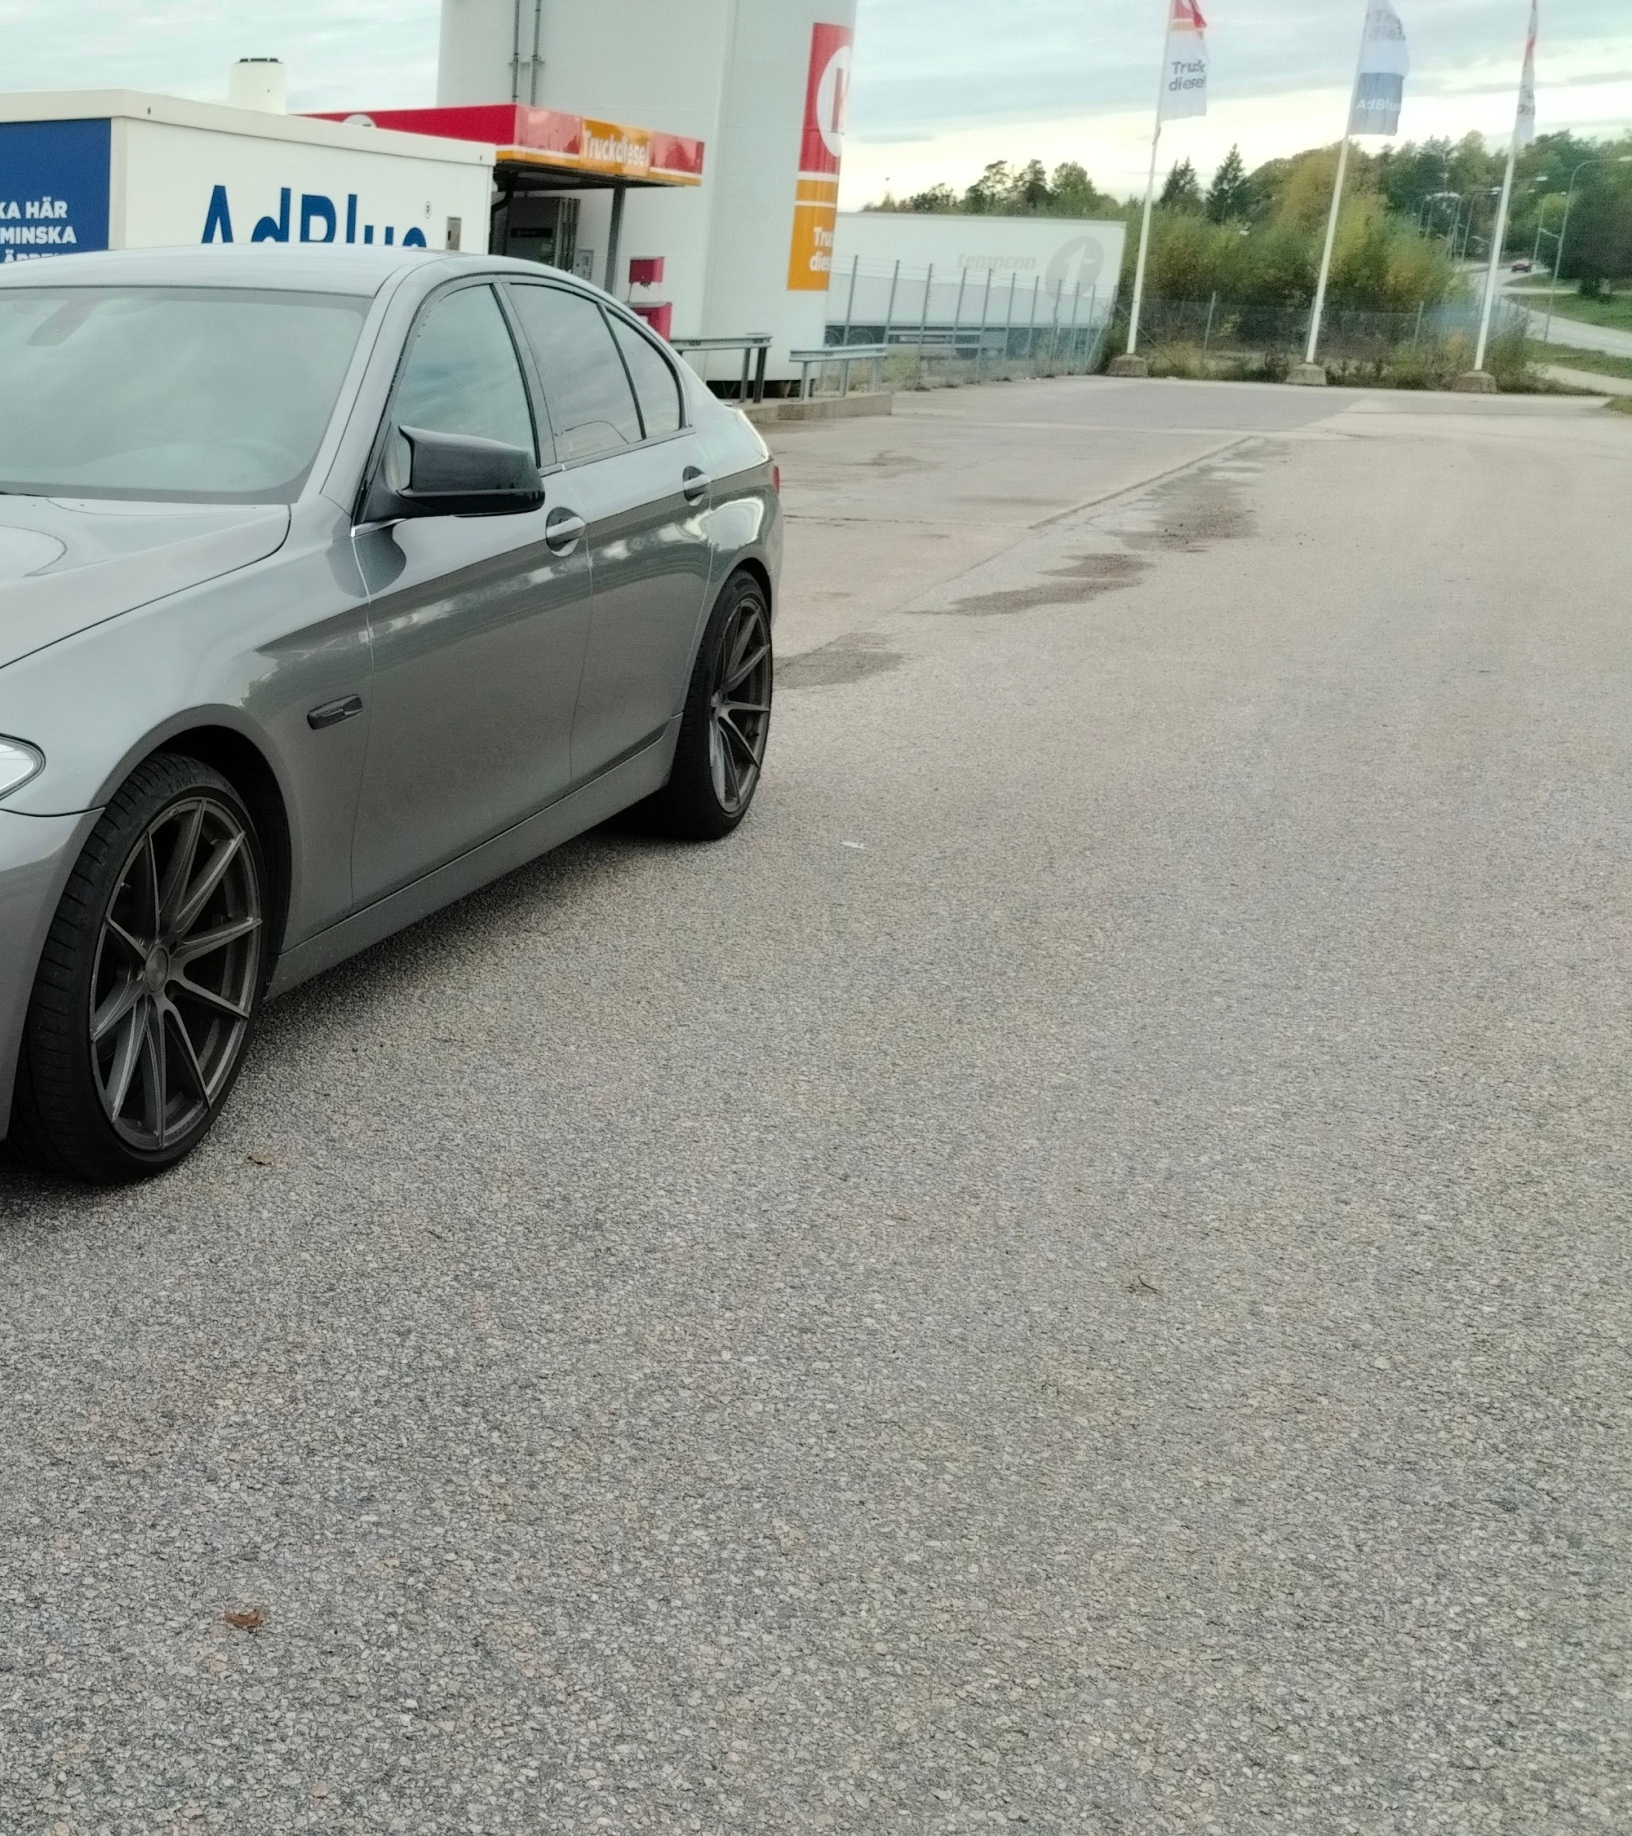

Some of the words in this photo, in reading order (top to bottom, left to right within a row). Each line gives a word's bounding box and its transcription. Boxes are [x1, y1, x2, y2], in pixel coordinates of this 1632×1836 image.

[25, 196, 68, 219] HÄR
[0, 226, 77, 244] MINSKA
[957, 254, 1037, 272] tempcon
